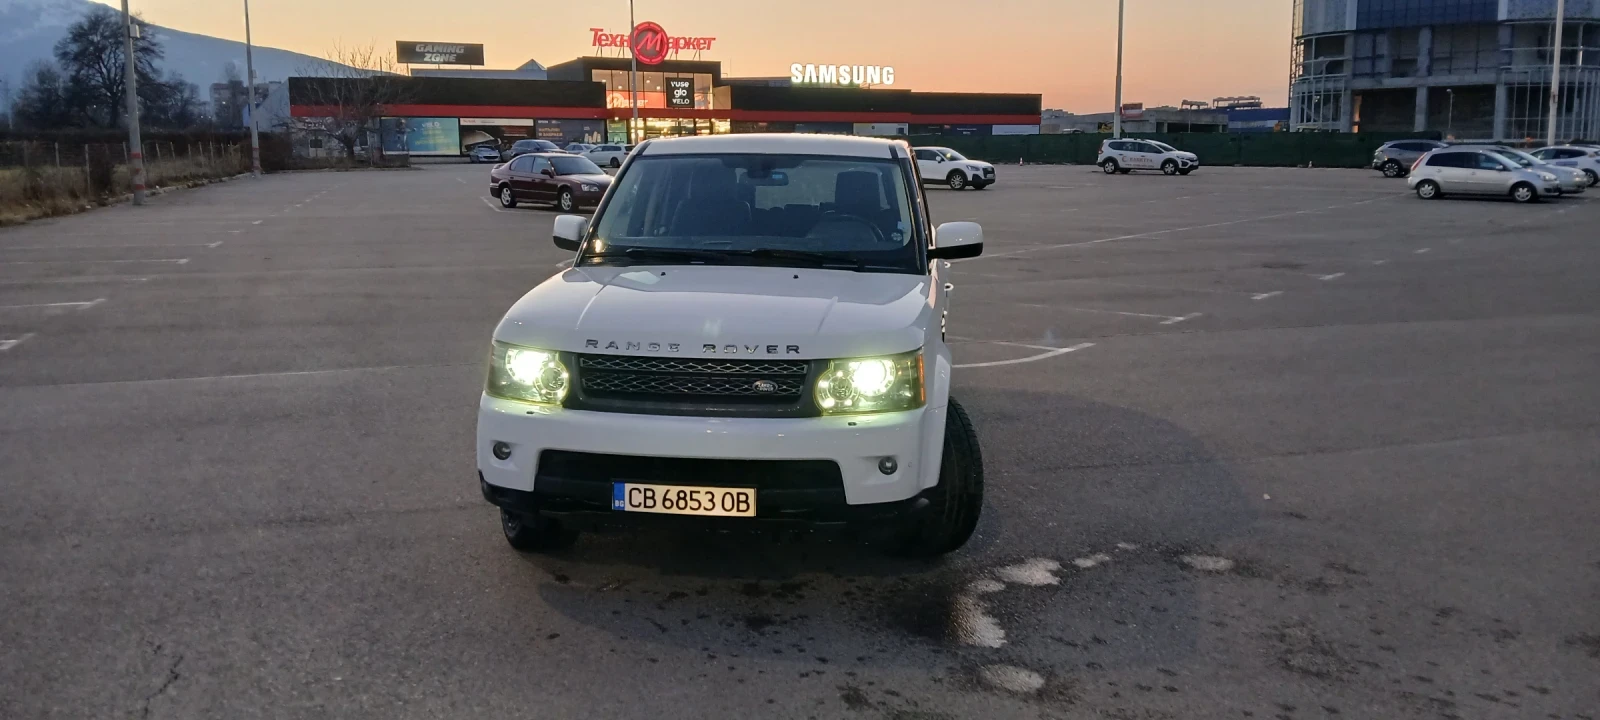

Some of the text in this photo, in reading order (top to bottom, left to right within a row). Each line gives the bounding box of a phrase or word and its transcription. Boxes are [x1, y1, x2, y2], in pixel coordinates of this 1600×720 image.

[415, 44, 465, 54] GAMING
[423, 53, 457, 62] ZONE
[790, 63, 895, 86] SAMSUNG
[674, 88, 687, 98] glo
[585, 339, 801, 355] RANGE ROVER
[614, 500, 625, 508] BG
[628, 487, 657, 509] CB
[661, 488, 716, 512] 6853
